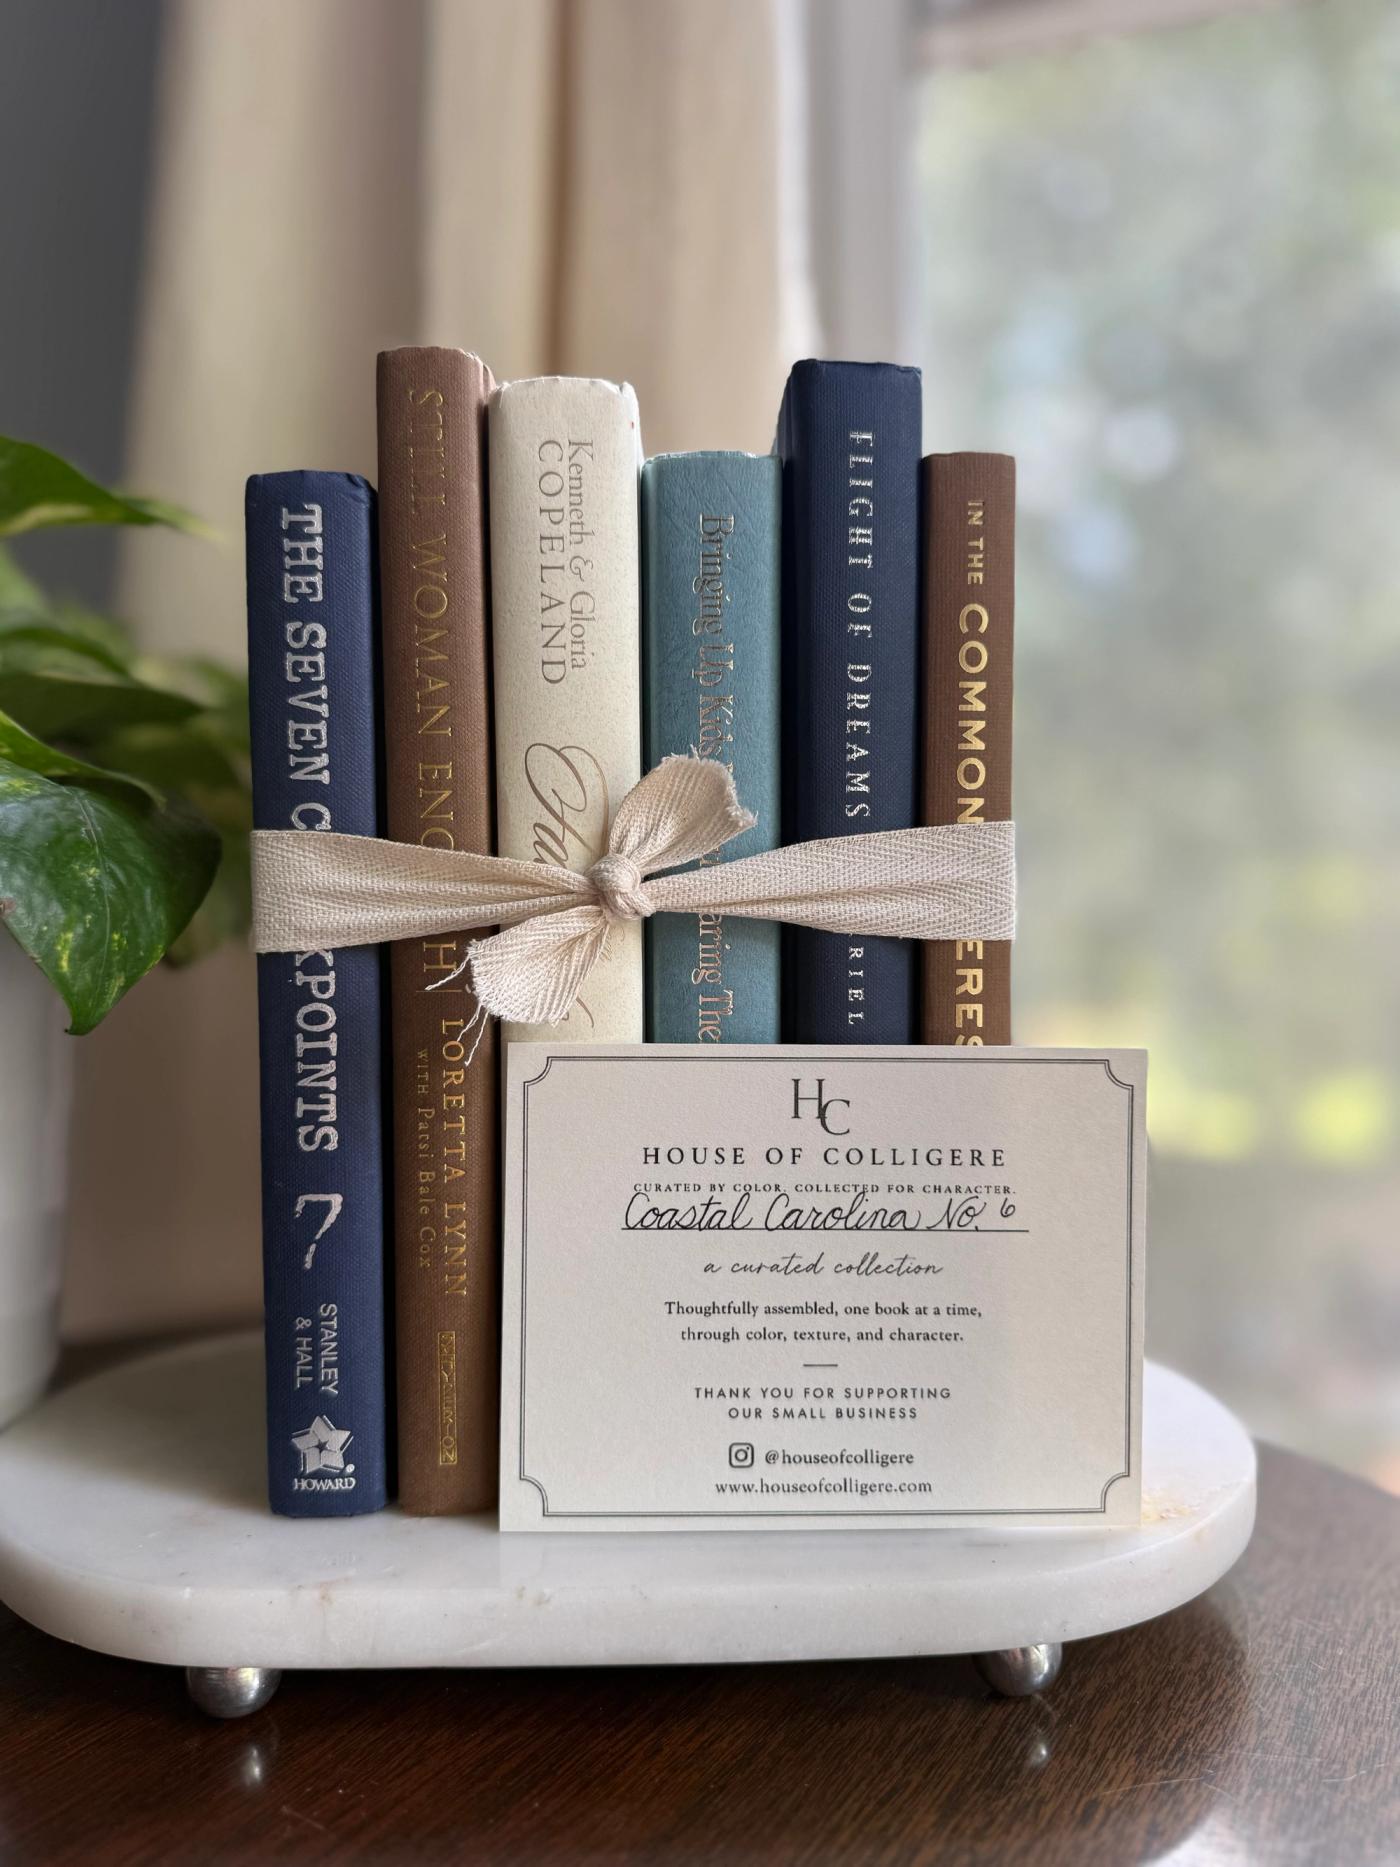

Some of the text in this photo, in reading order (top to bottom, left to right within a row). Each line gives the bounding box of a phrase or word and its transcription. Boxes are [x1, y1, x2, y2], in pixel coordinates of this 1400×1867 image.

[967, 501, 984, 526] IN
[538, 438, 567, 685] COPELAND
[568, 438, 596, 670] Kenneth & Gloria
[692, 512, 735, 636] Bringing
[967, 536, 984, 585] THE
[845, 431, 874, 817] FLIGHT OF DREAMS
[409, 389, 457, 973] STILL WOMAN ENOH
[692, 642, 735, 687] Up
[699, 693, 735, 758] Kids
[957, 603, 989, 825] COMMON
[281, 503, 339, 1153] THE SEVEN CKPOINTS
[848, 931, 865, 1025] RIEL
[417, 1048, 430, 1095] WITH
[442, 1018, 467, 1295] LORETTA LYNN
[642, 1147, 1006, 1167] HOUSE OF COLLIGERE
[418, 1170, 436, 1215] Bale
[625, 1191, 754, 1232] Coastal
[765, 1190, 922, 1232] Carolina
[999, 1197, 1016, 1218] 6
[633, 1183, 1017, 1195] CURATED BY COLOR. COLLECTED FOR CHARACTER.
[295, 1193, 344, 1270] 7
[419, 1226, 436, 1268] Cox
[703, 1251, 944, 1277] a curated collection
[664, 1301, 982, 1318] Thoughtfully assembled, one book at a time,
[295, 1316, 313, 1390] & HALL
[319, 1303, 339, 1395] STANLEY
[681, 1327, 964, 1343] through color, texture, and character.
[695, 1387, 951, 1399] THANK YOU FOR SUPPORTING
[728, 1407, 918, 1419] OUR SMALL BUSINESS
[765, 1450, 915, 1468] @houseofcolligere
[293, 1477, 357, 1492] HOWARD
[715, 1478, 933, 1496] www.houseofcolligere.com
